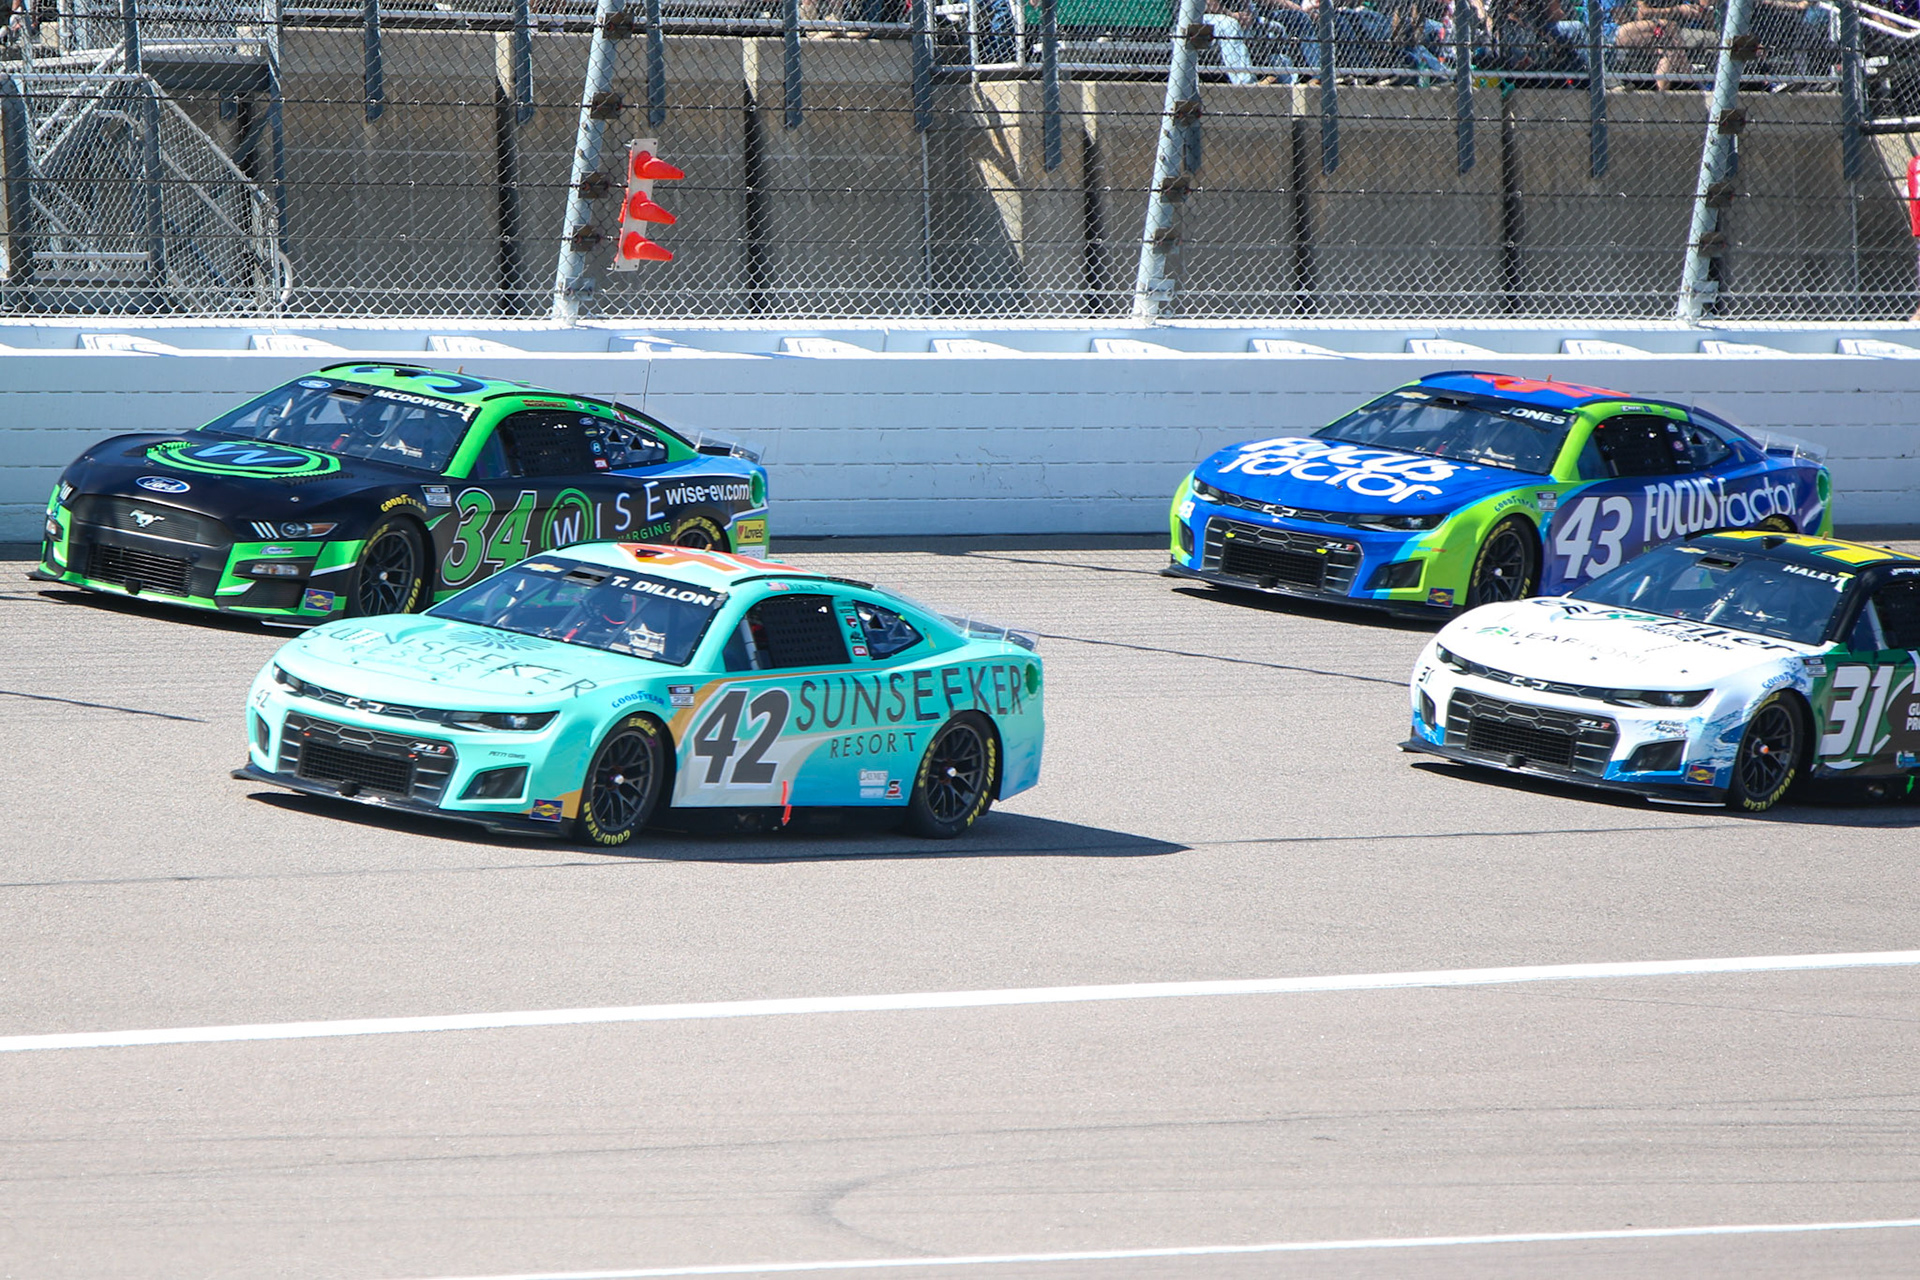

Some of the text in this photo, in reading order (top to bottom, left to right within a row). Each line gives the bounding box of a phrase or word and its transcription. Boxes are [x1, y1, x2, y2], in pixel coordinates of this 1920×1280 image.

[1501, 406, 1567, 425] JONES
[665, 483, 749, 506] wise-ev.com
[441, 487, 537, 588] 34
[1555, 496, 1633, 580] 43
[610, 576, 713, 607] T. DILLON
[1783, 565, 1841, 583] HALEY
[611, 690, 665, 709] GOODYEAR
[795, 664, 1024, 732] SUNSEEKER
[1818, 664, 1896, 757] 31
[692, 688, 791, 786] 42
[830, 732, 917, 759] RESORT
[583, 801, 631, 846] GOODYEAR
